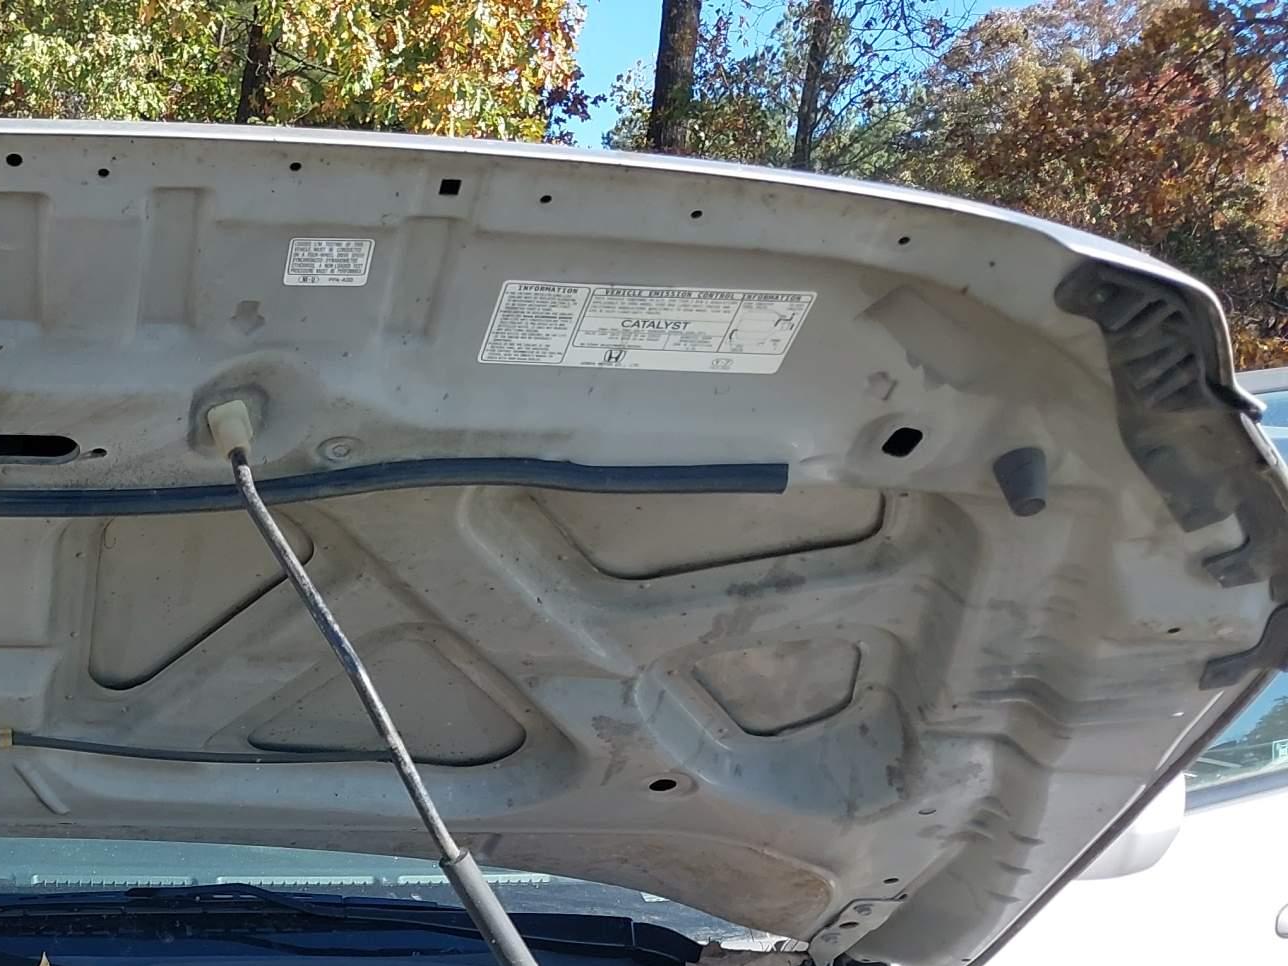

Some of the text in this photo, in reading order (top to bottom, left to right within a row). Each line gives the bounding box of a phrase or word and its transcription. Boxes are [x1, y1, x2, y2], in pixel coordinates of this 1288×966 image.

[518, 286, 578, 294] INFORMATION
[698, 291, 734, 299] CONTROL
[742, 293, 801, 301] INFORMATION
[621, 320, 690, 330] CATALYST
